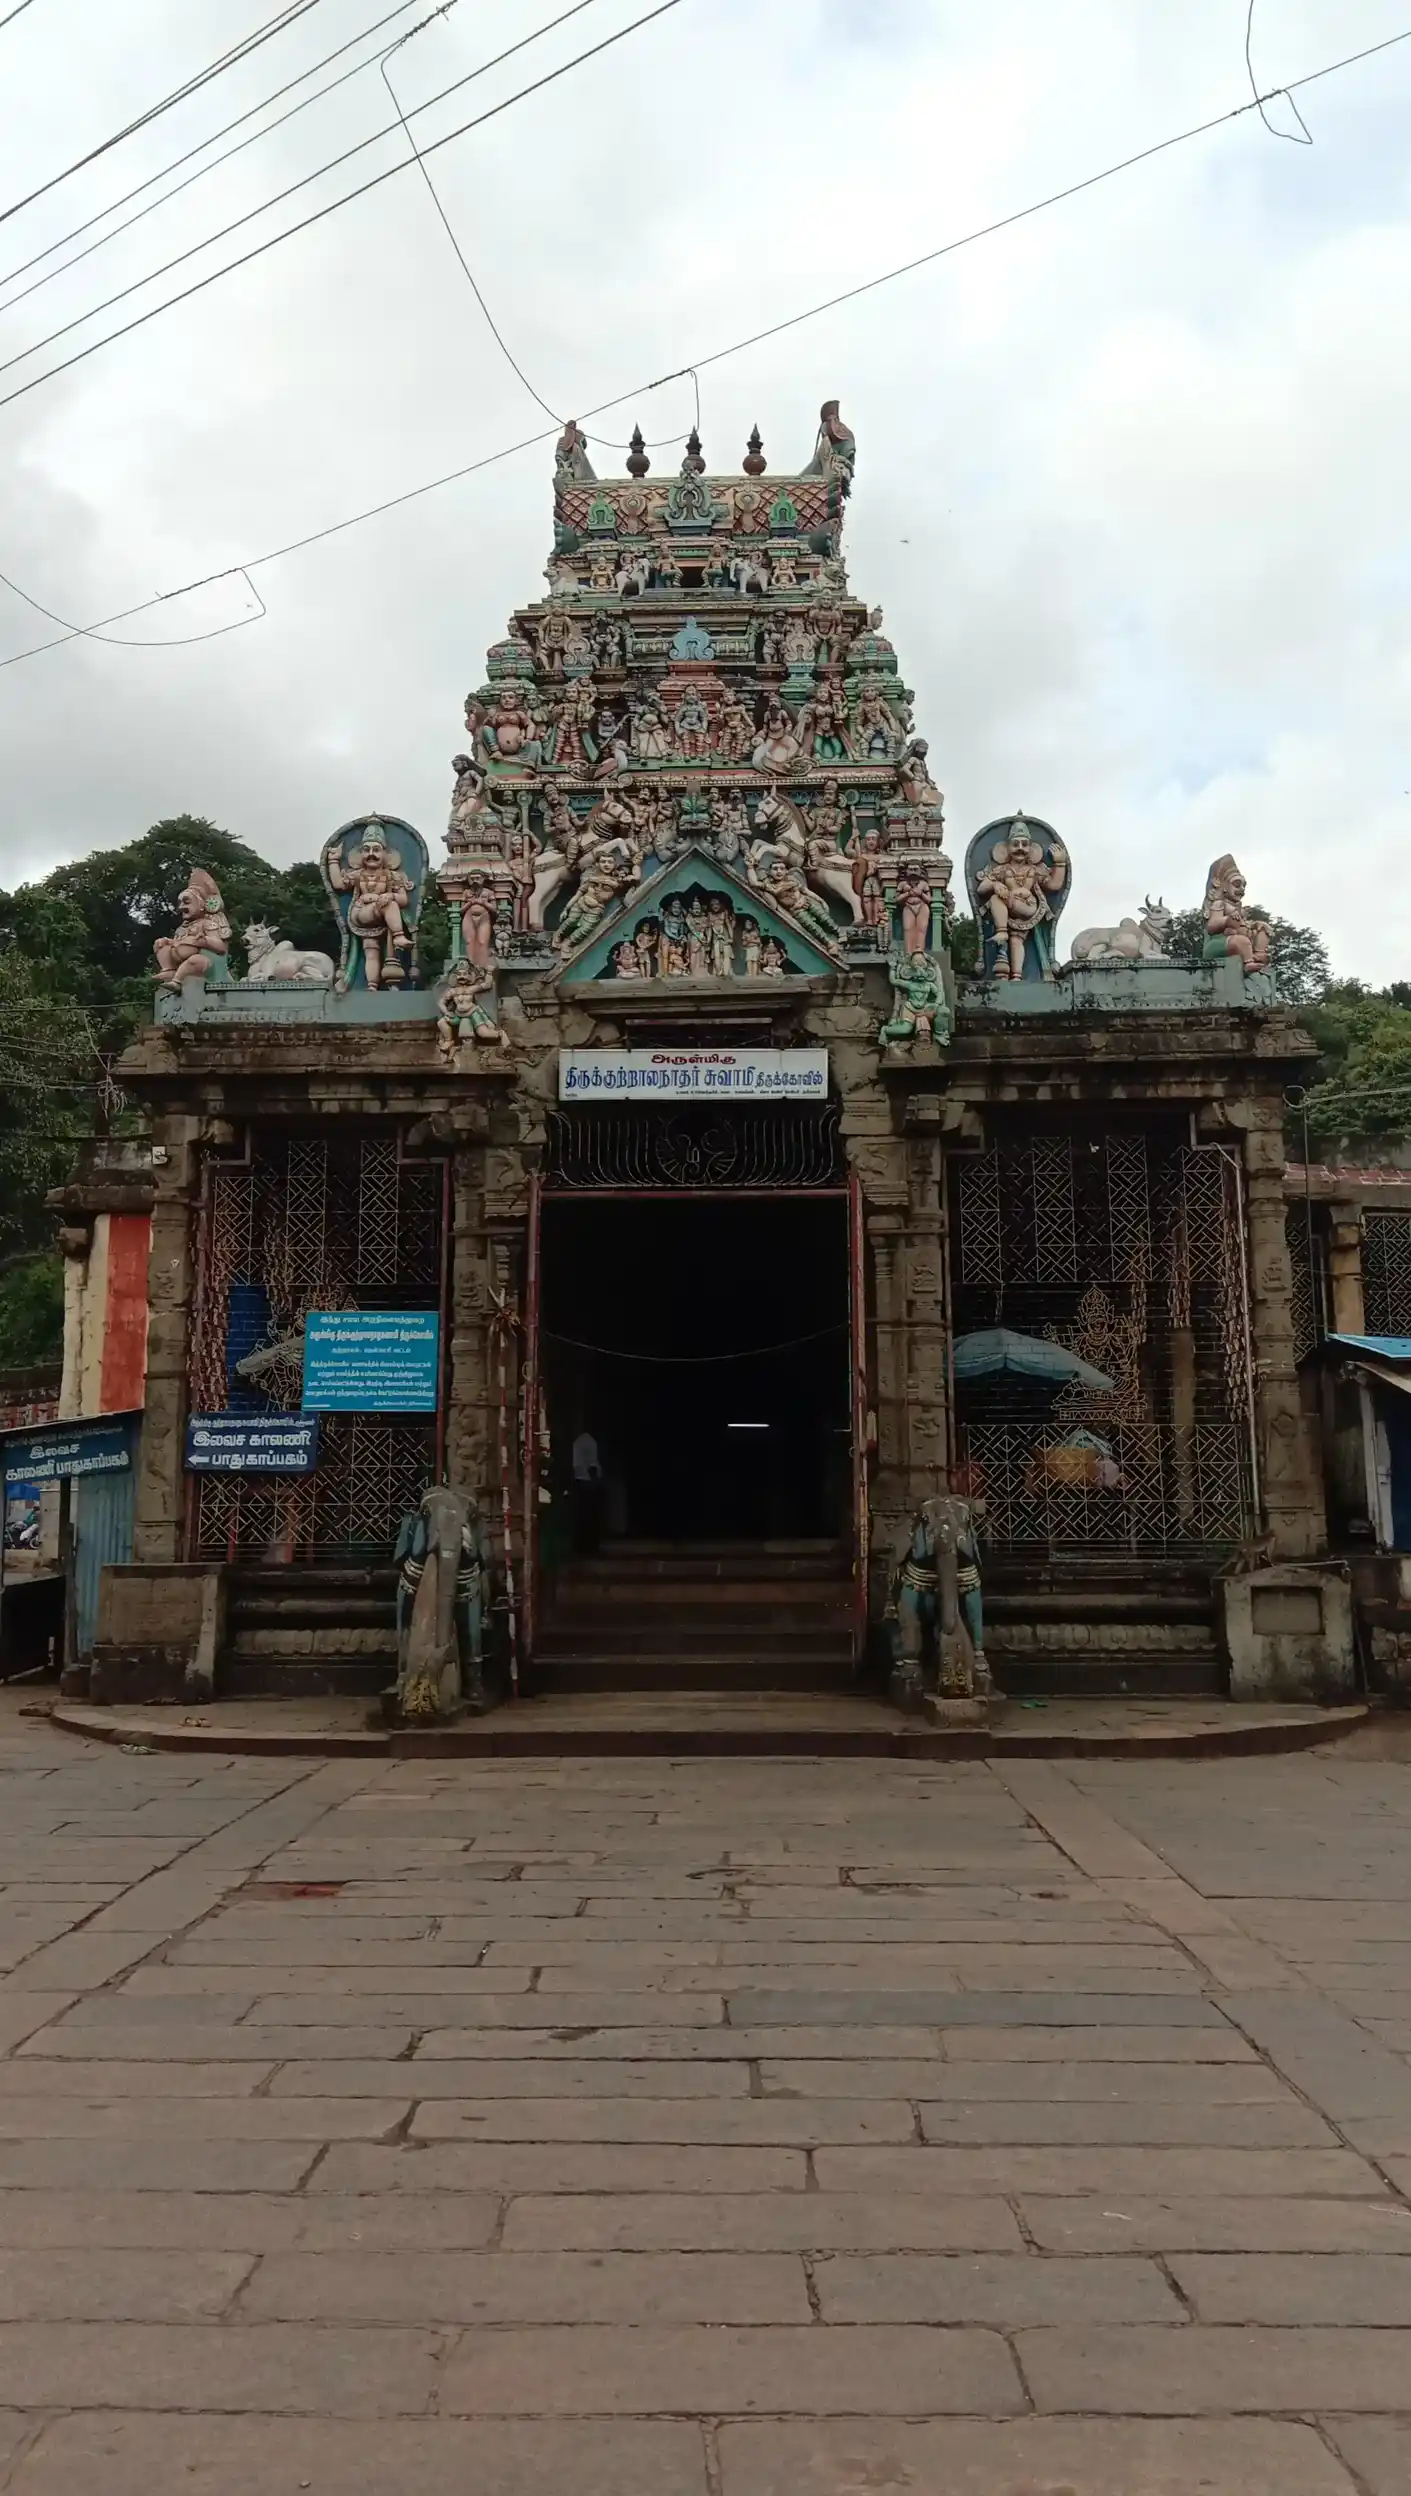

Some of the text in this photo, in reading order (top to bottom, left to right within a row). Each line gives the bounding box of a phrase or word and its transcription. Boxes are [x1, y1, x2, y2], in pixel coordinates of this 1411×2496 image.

[650, 1052, 737, 1065] அருள்மிகு
[564, 1064, 824, 1090] திருக்குற்றாலநாதர் சுவாமி திருக்கோவில்
[193, 1430, 312, 1447] இலவச காலணி
[29, 1443, 81, 1460] இலவச
[211, 1449, 309, 1470] பாதுகாப்பகம்
[6, 1451, 129, 1481] காலணி பாதுகாப்பகம்
